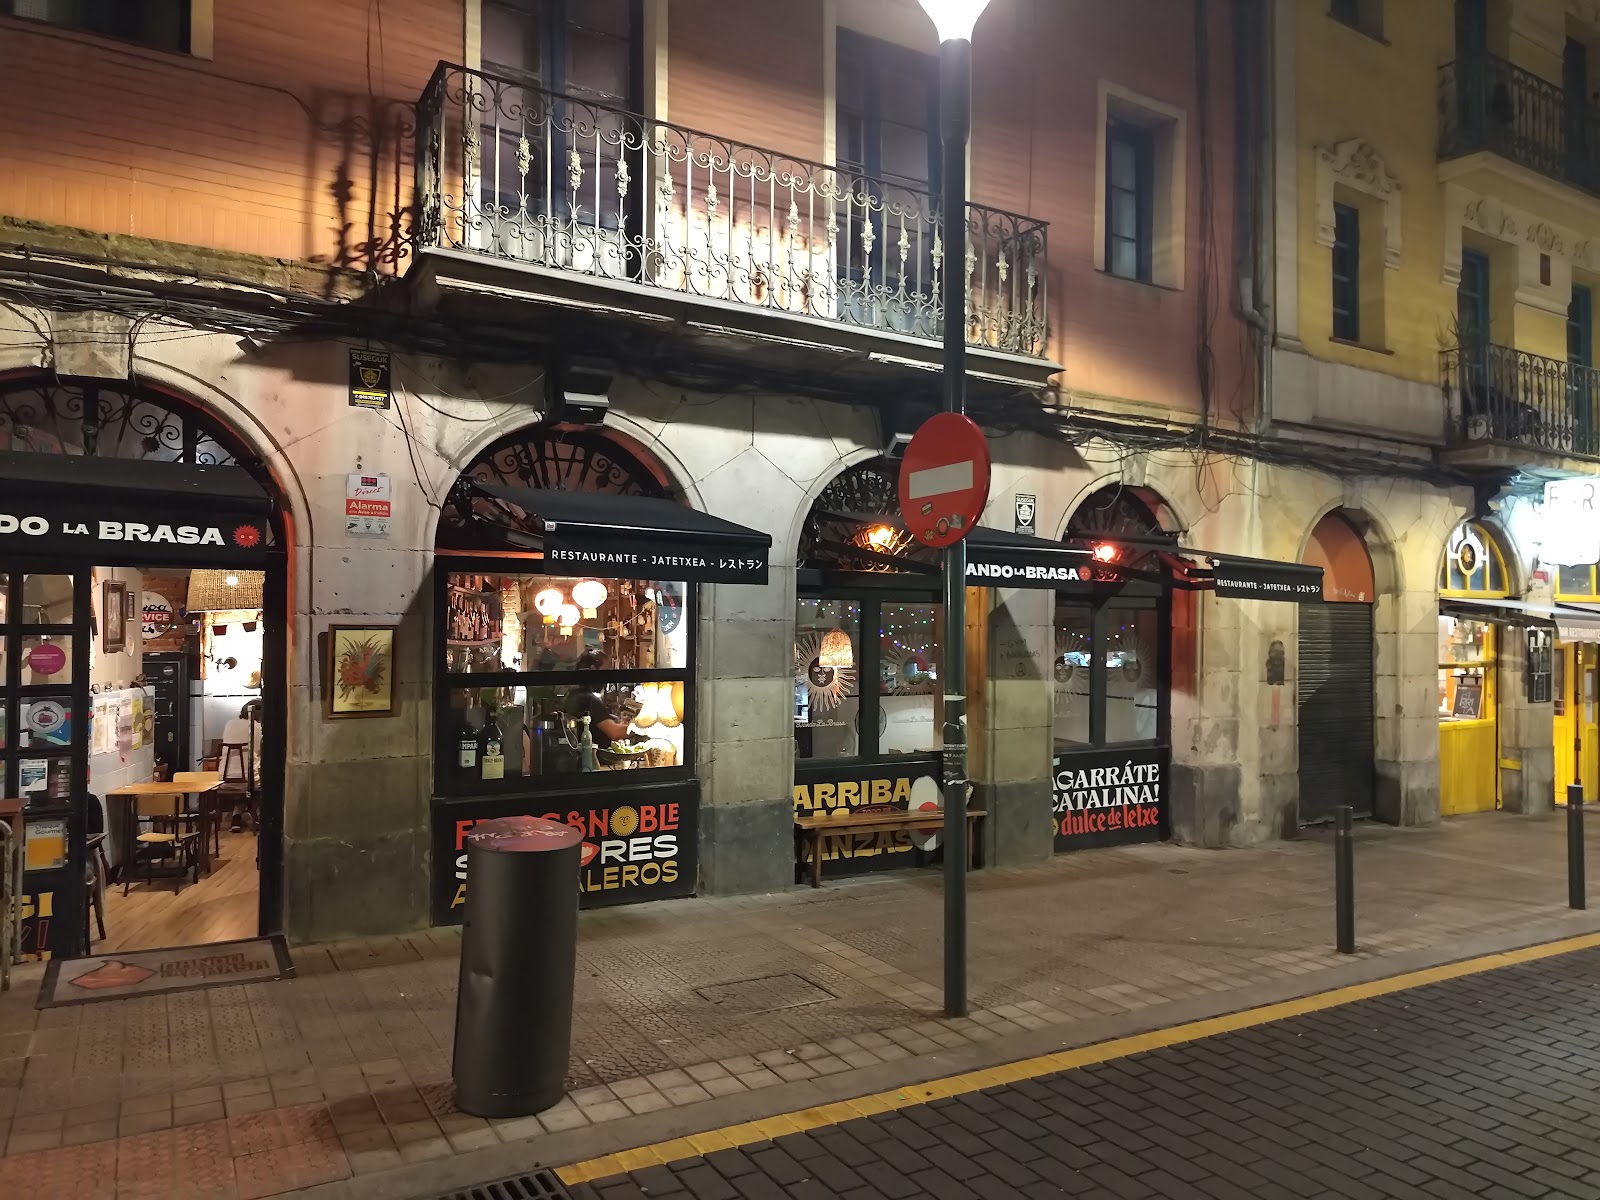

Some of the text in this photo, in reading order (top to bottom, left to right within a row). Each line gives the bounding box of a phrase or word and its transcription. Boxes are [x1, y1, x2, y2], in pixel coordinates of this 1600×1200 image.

[349, 501, 389, 511] Alarma
[62, 522, 90, 535] LA
[98, 520, 226, 546] BRASA
[551, 549, 638, 565] RESTAURANTE
[651, 555, 707, 568] JATETXEA
[719, 558, 763, 571] レストラン
[965, 563, 1080, 581] ANDO LA BRASA
[1216, 579, 1258, 590] RESTAURANTE
[1263, 583, 1292, 592] JATETXEA
[142, 613, 170, 621] VICE
[793, 777, 911, 811] ARRIBA
[1061, 803, 1159, 836] dulce de letxe
